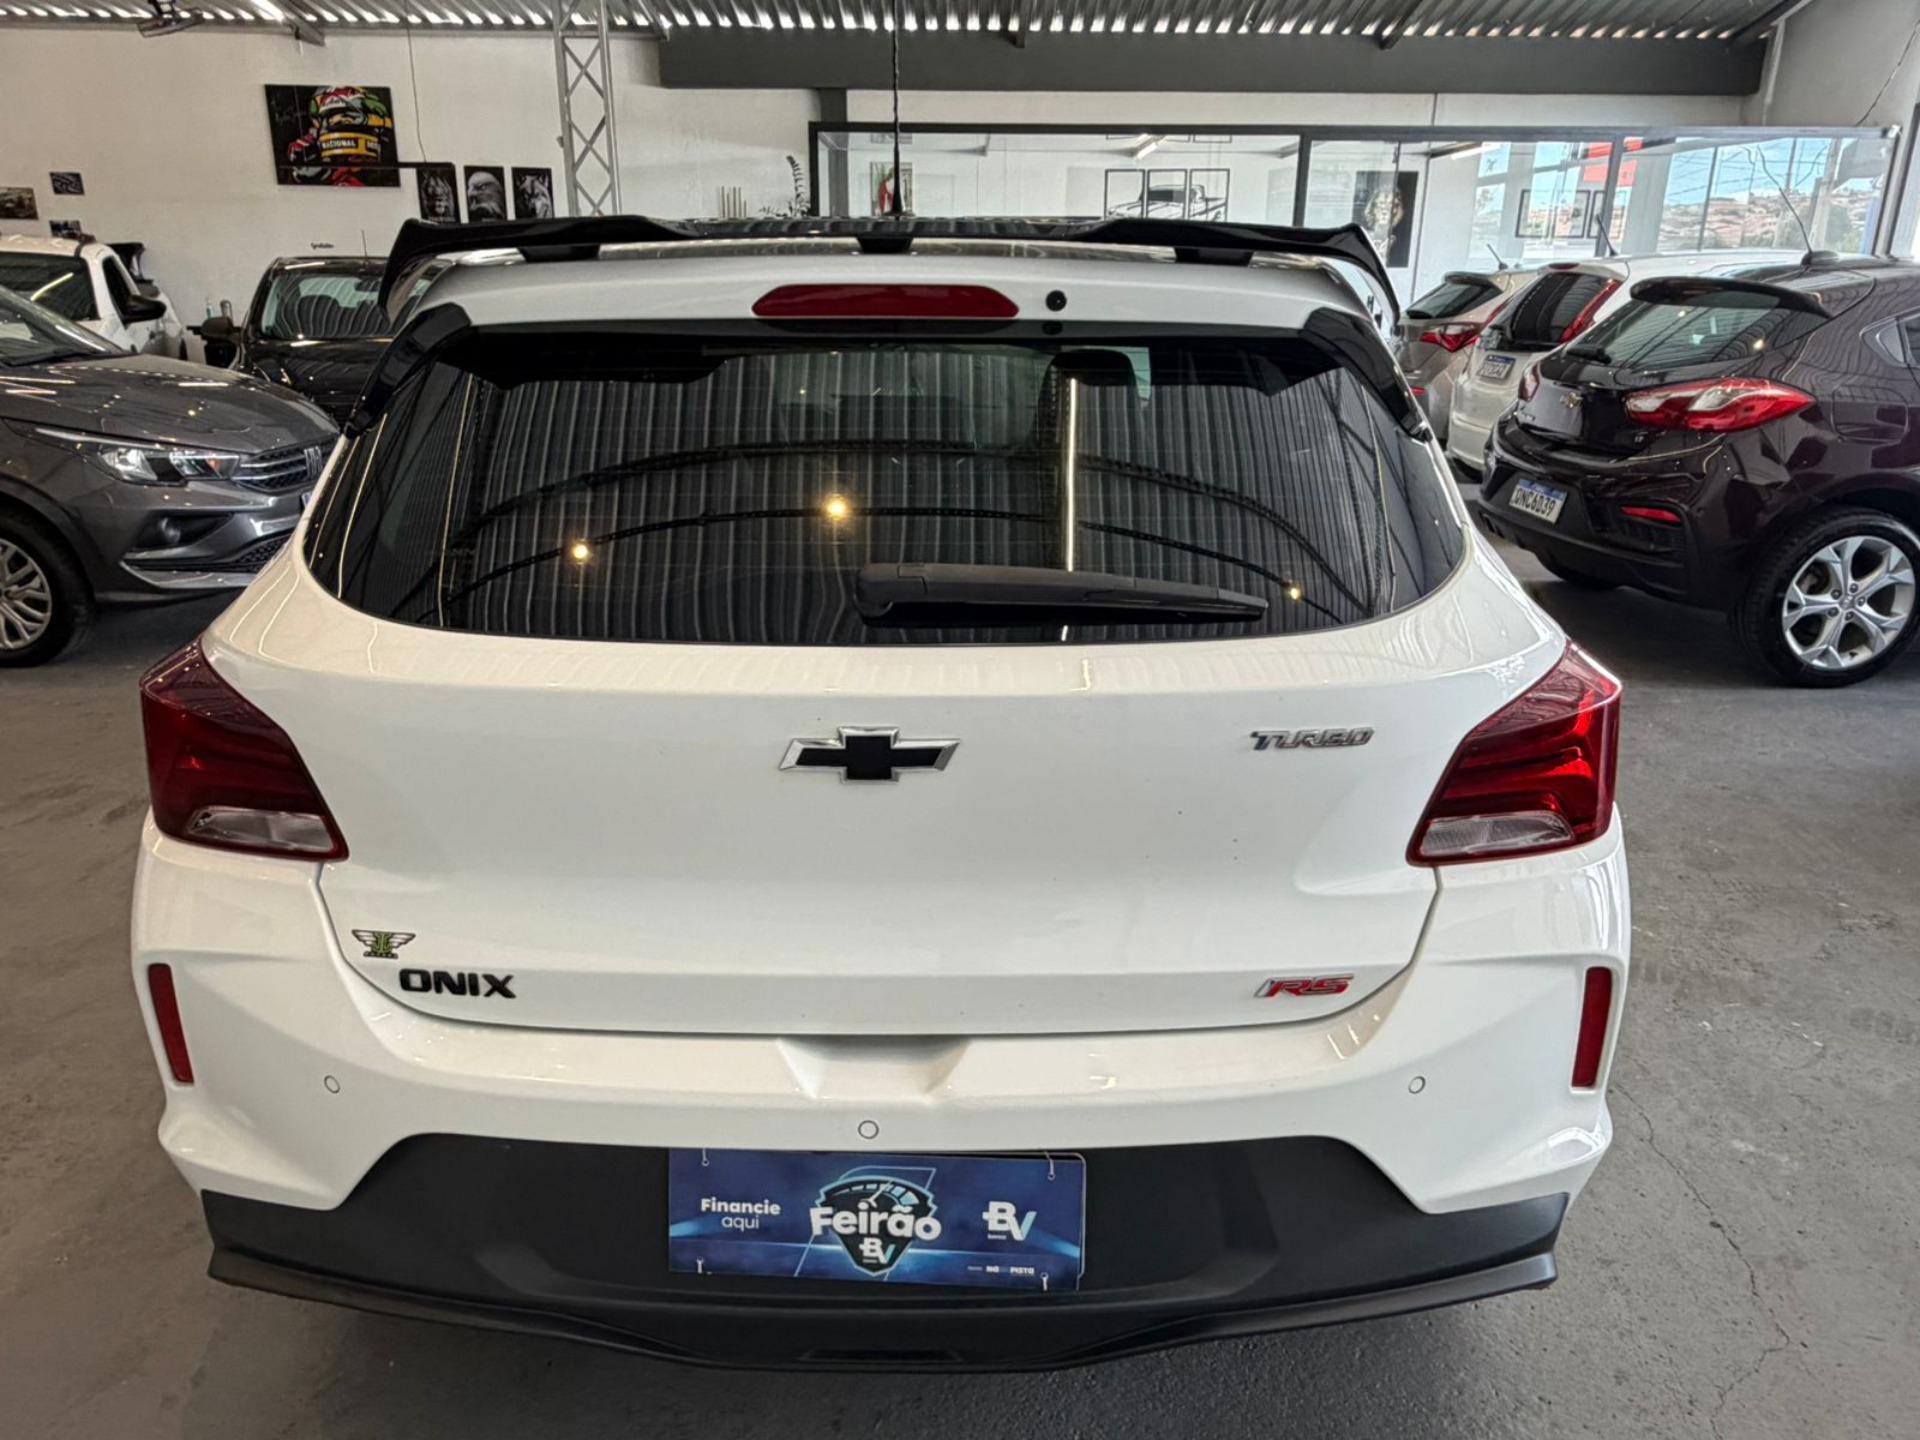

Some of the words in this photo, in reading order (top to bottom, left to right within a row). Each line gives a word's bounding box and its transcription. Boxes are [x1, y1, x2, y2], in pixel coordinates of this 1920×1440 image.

[1250, 728, 1375, 751] TURBO
[399, 968, 516, 999] ONIX
[1255, 973, 1353, 998] RS
[701, 1196, 781, 1215] Financie
[721, 1214, 760, 1232] aqui
[809, 1201, 942, 1241] Feirão
[982, 1201, 1037, 1241] BV
[859, 1237, 896, 1264] BV
